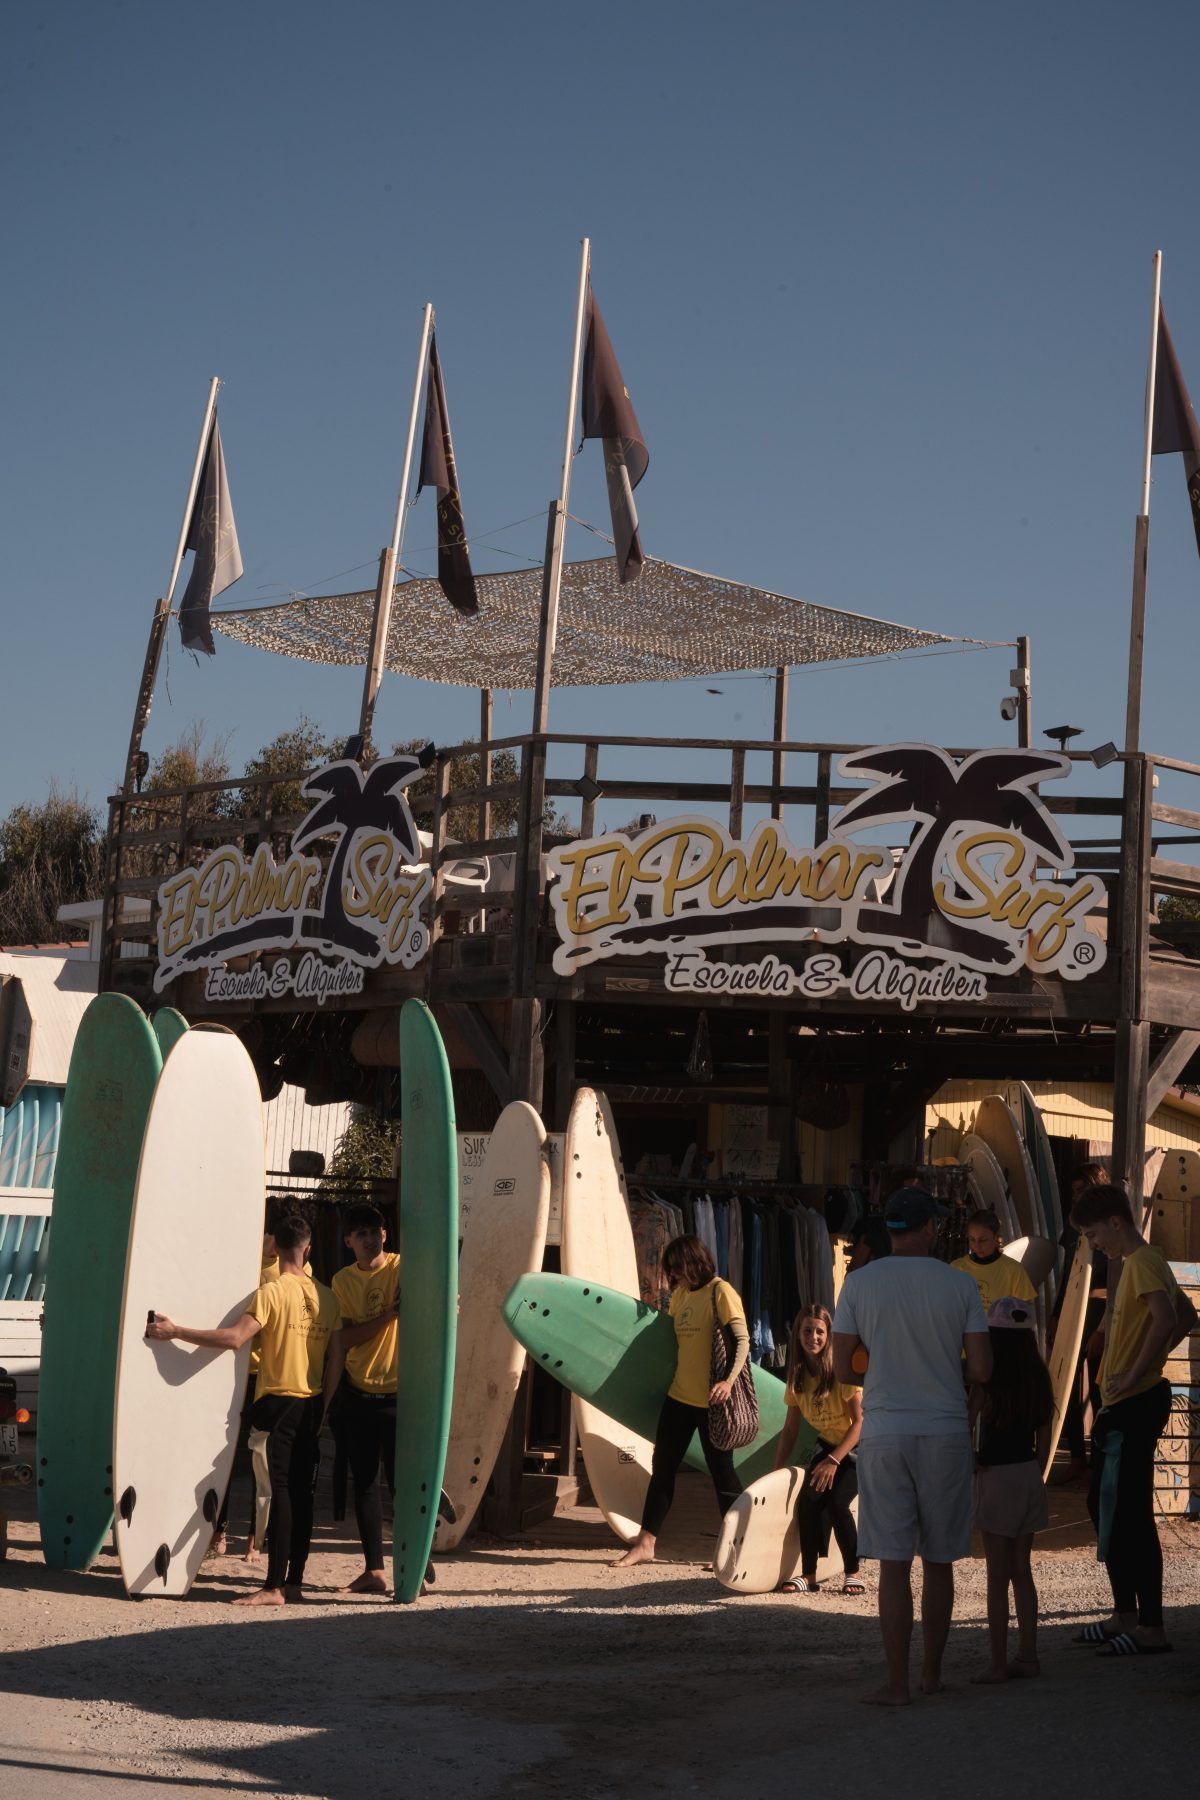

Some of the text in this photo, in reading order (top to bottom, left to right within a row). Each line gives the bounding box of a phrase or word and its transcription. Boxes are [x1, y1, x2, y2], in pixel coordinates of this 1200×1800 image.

[163, 874, 200, 956] El
[198, 851, 317, 936] Palmar
[341, 834, 427, 951] Surf
[560, 841, 631, 934] El
[631, 823, 884, 917] Palmar
[933, 832, 1095, 962] Surf
[207, 956, 361, 1001] Escuela & Alquiler
[669, 953, 982, 1007] Escuela & Alquiler
